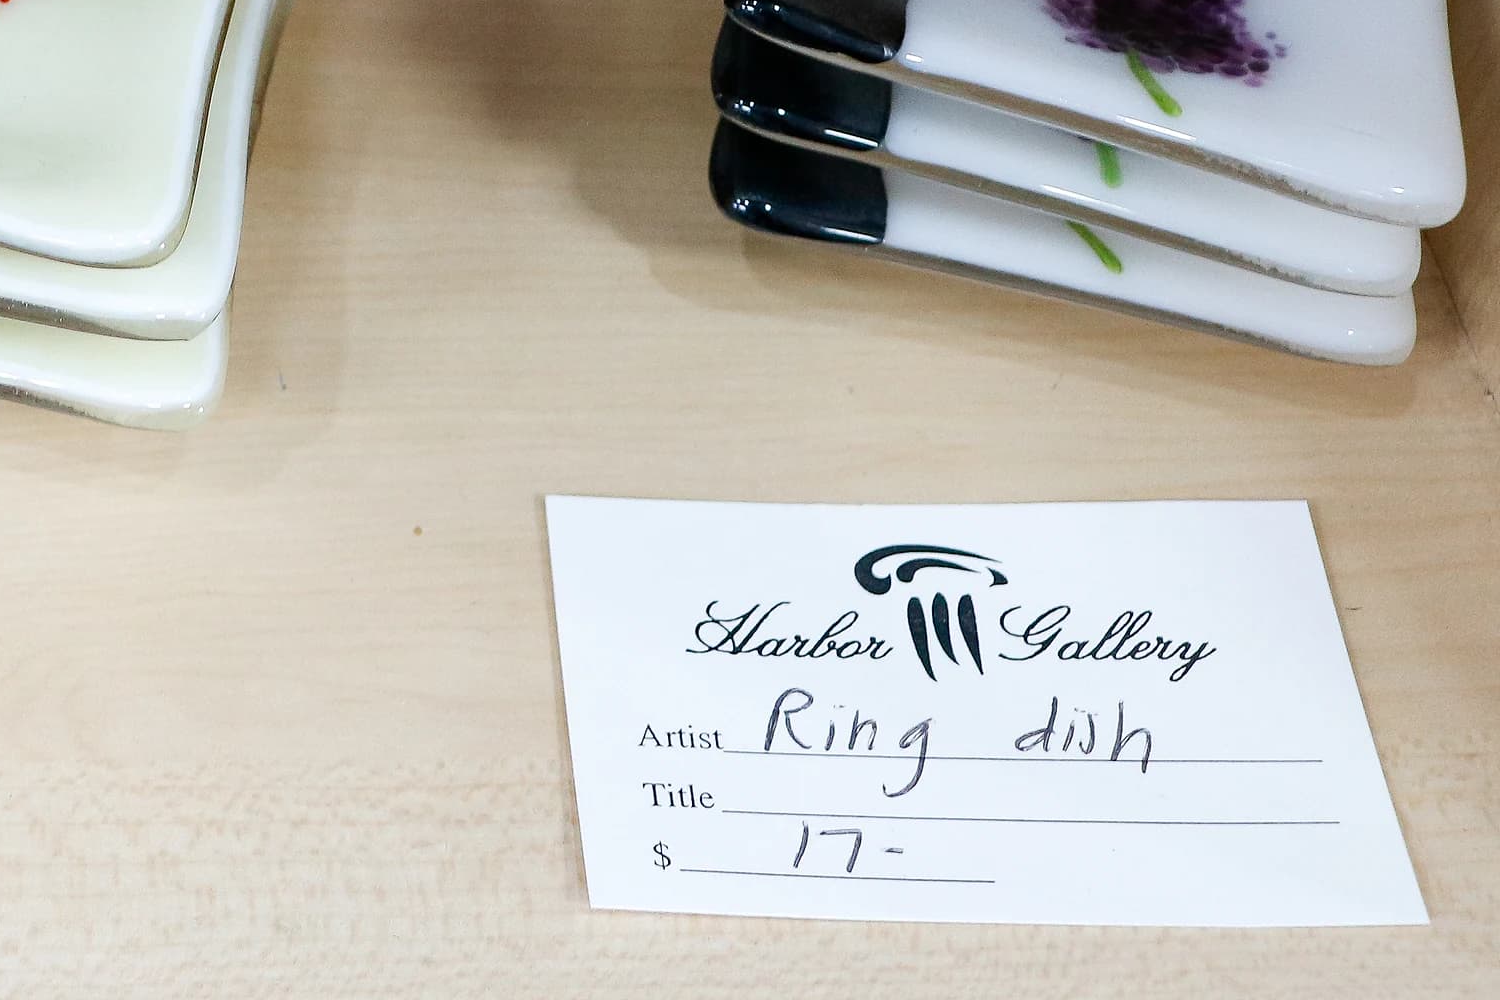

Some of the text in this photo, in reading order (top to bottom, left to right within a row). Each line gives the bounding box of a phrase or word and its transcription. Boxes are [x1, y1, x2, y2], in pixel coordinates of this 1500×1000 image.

[686, 601, 1217, 683] Harbor Gallery
[638, 687, 1153, 798] Artist Ring dish
[642, 782, 715, 811] Title
[652, 842, 672, 872] $
